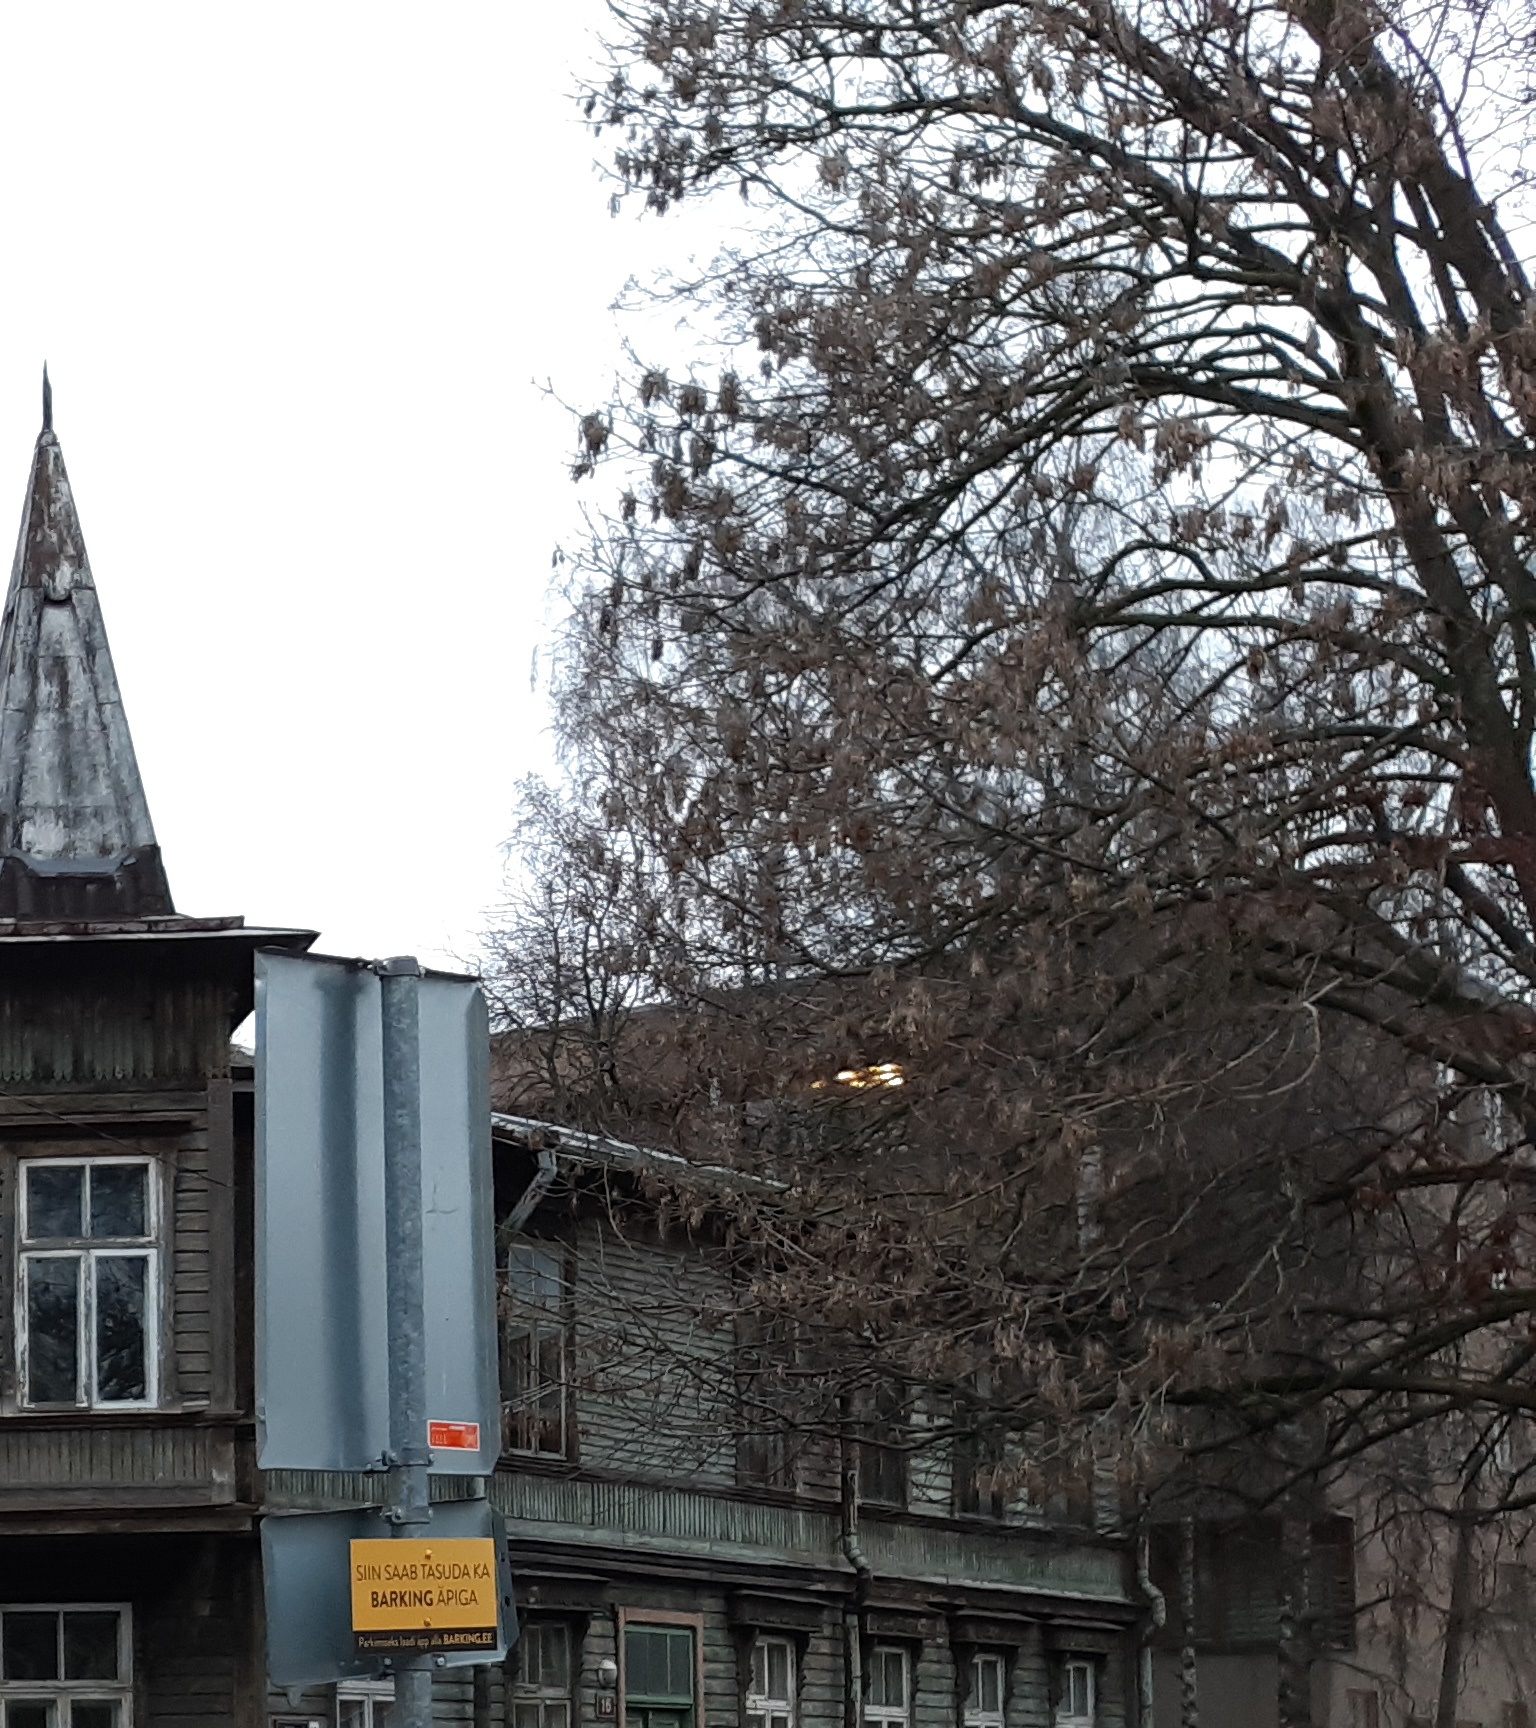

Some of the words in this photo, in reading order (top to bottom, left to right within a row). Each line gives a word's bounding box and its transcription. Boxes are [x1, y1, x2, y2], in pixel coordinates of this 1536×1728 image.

[356, 1565, 381, 1582] SIIN
[384, 1564, 418, 1581] SAAB
[420, 1563, 471, 1580] TASUDA
[473, 1563, 491, 1579] KA
[371, 1589, 433, 1608] BARKING
[358, 1636, 399, 1648] Parkeks
